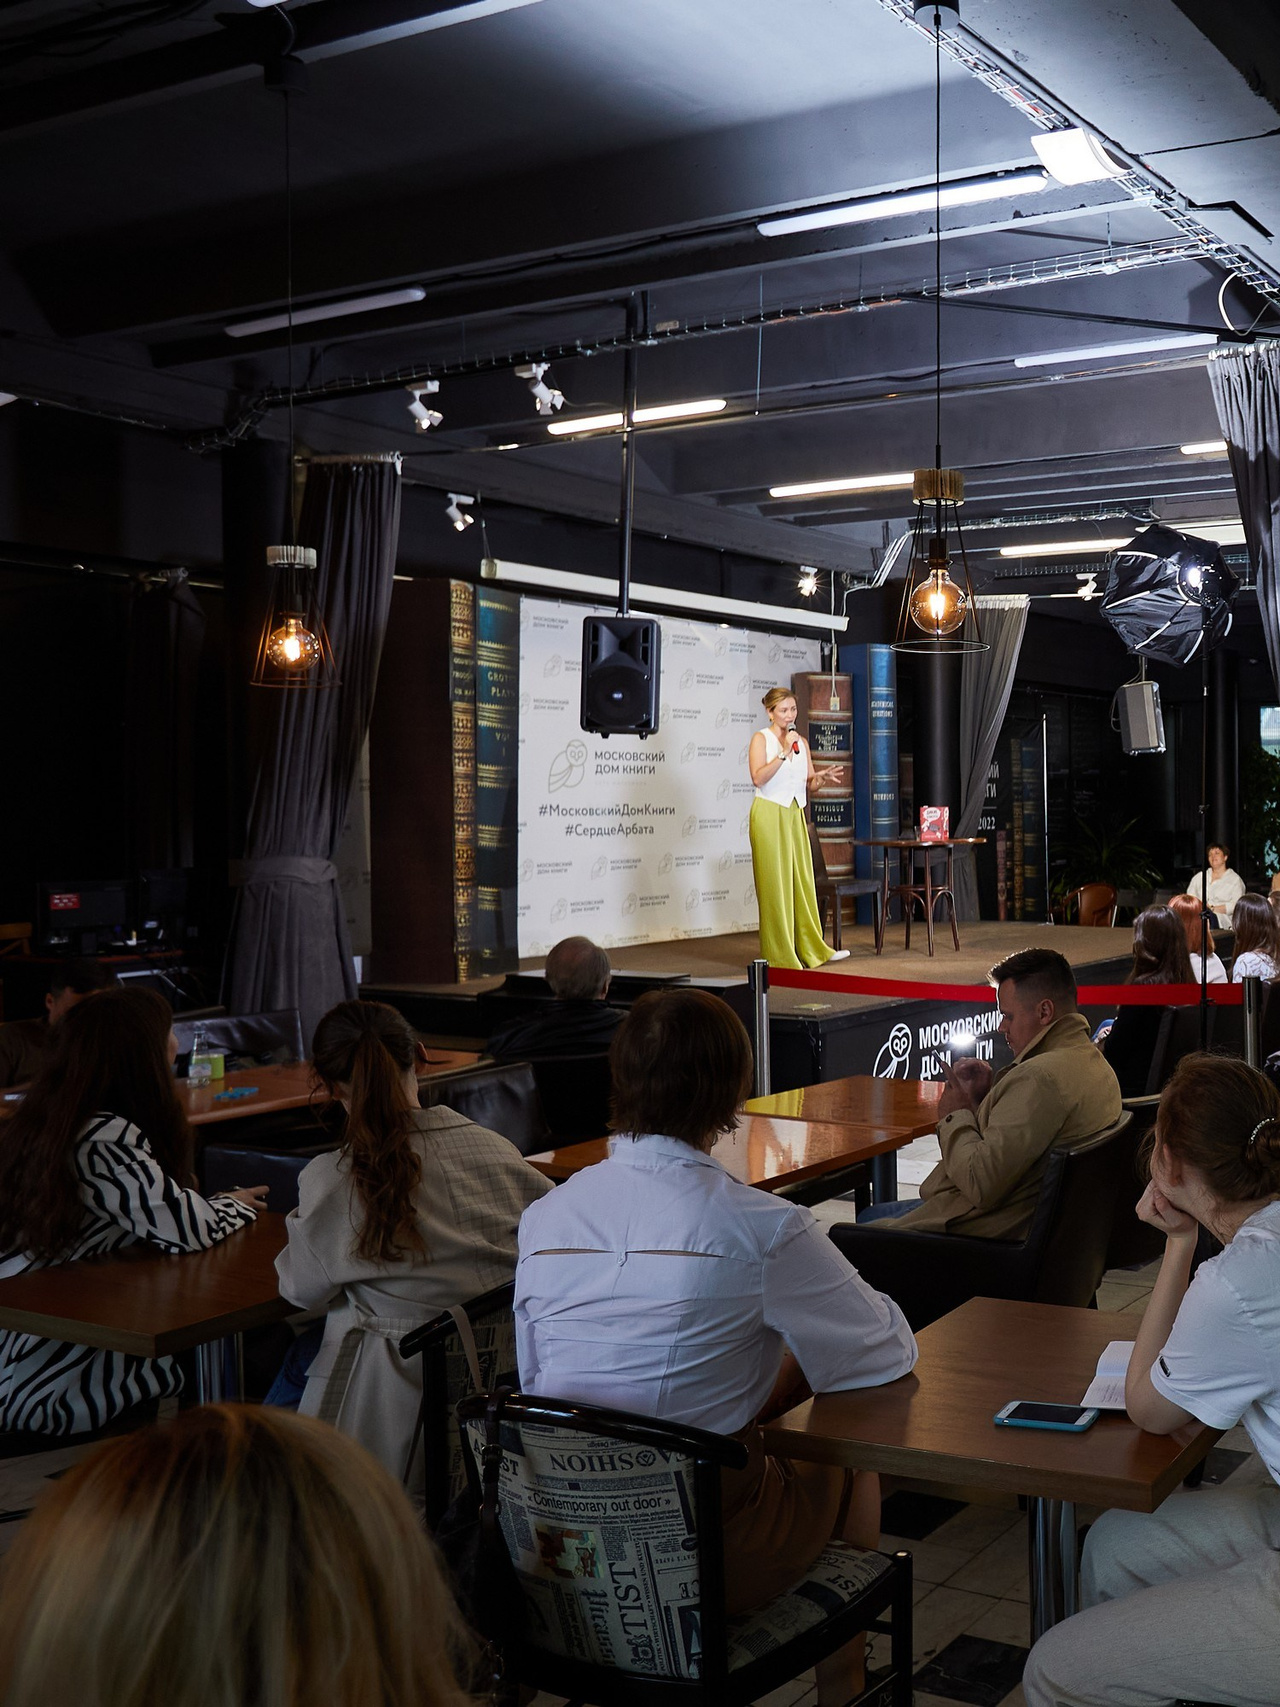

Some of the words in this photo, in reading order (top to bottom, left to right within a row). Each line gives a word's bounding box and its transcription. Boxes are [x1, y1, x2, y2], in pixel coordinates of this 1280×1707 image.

[594, 750, 666, 762] МОСКОВСКИЙ
[595, 764, 620, 775] ДОМ
[622, 764, 656, 774] КНИГИ
[538, 804, 676, 817] #МосковскийДомКниги
[978, 816, 996, 830] 2022
[565, 823, 654, 838] #СердцеАрбата
[533, 1492, 608, 1515] Contemporary
[611, 1500, 630, 1512] out
[633, 1496, 662, 1510] door
